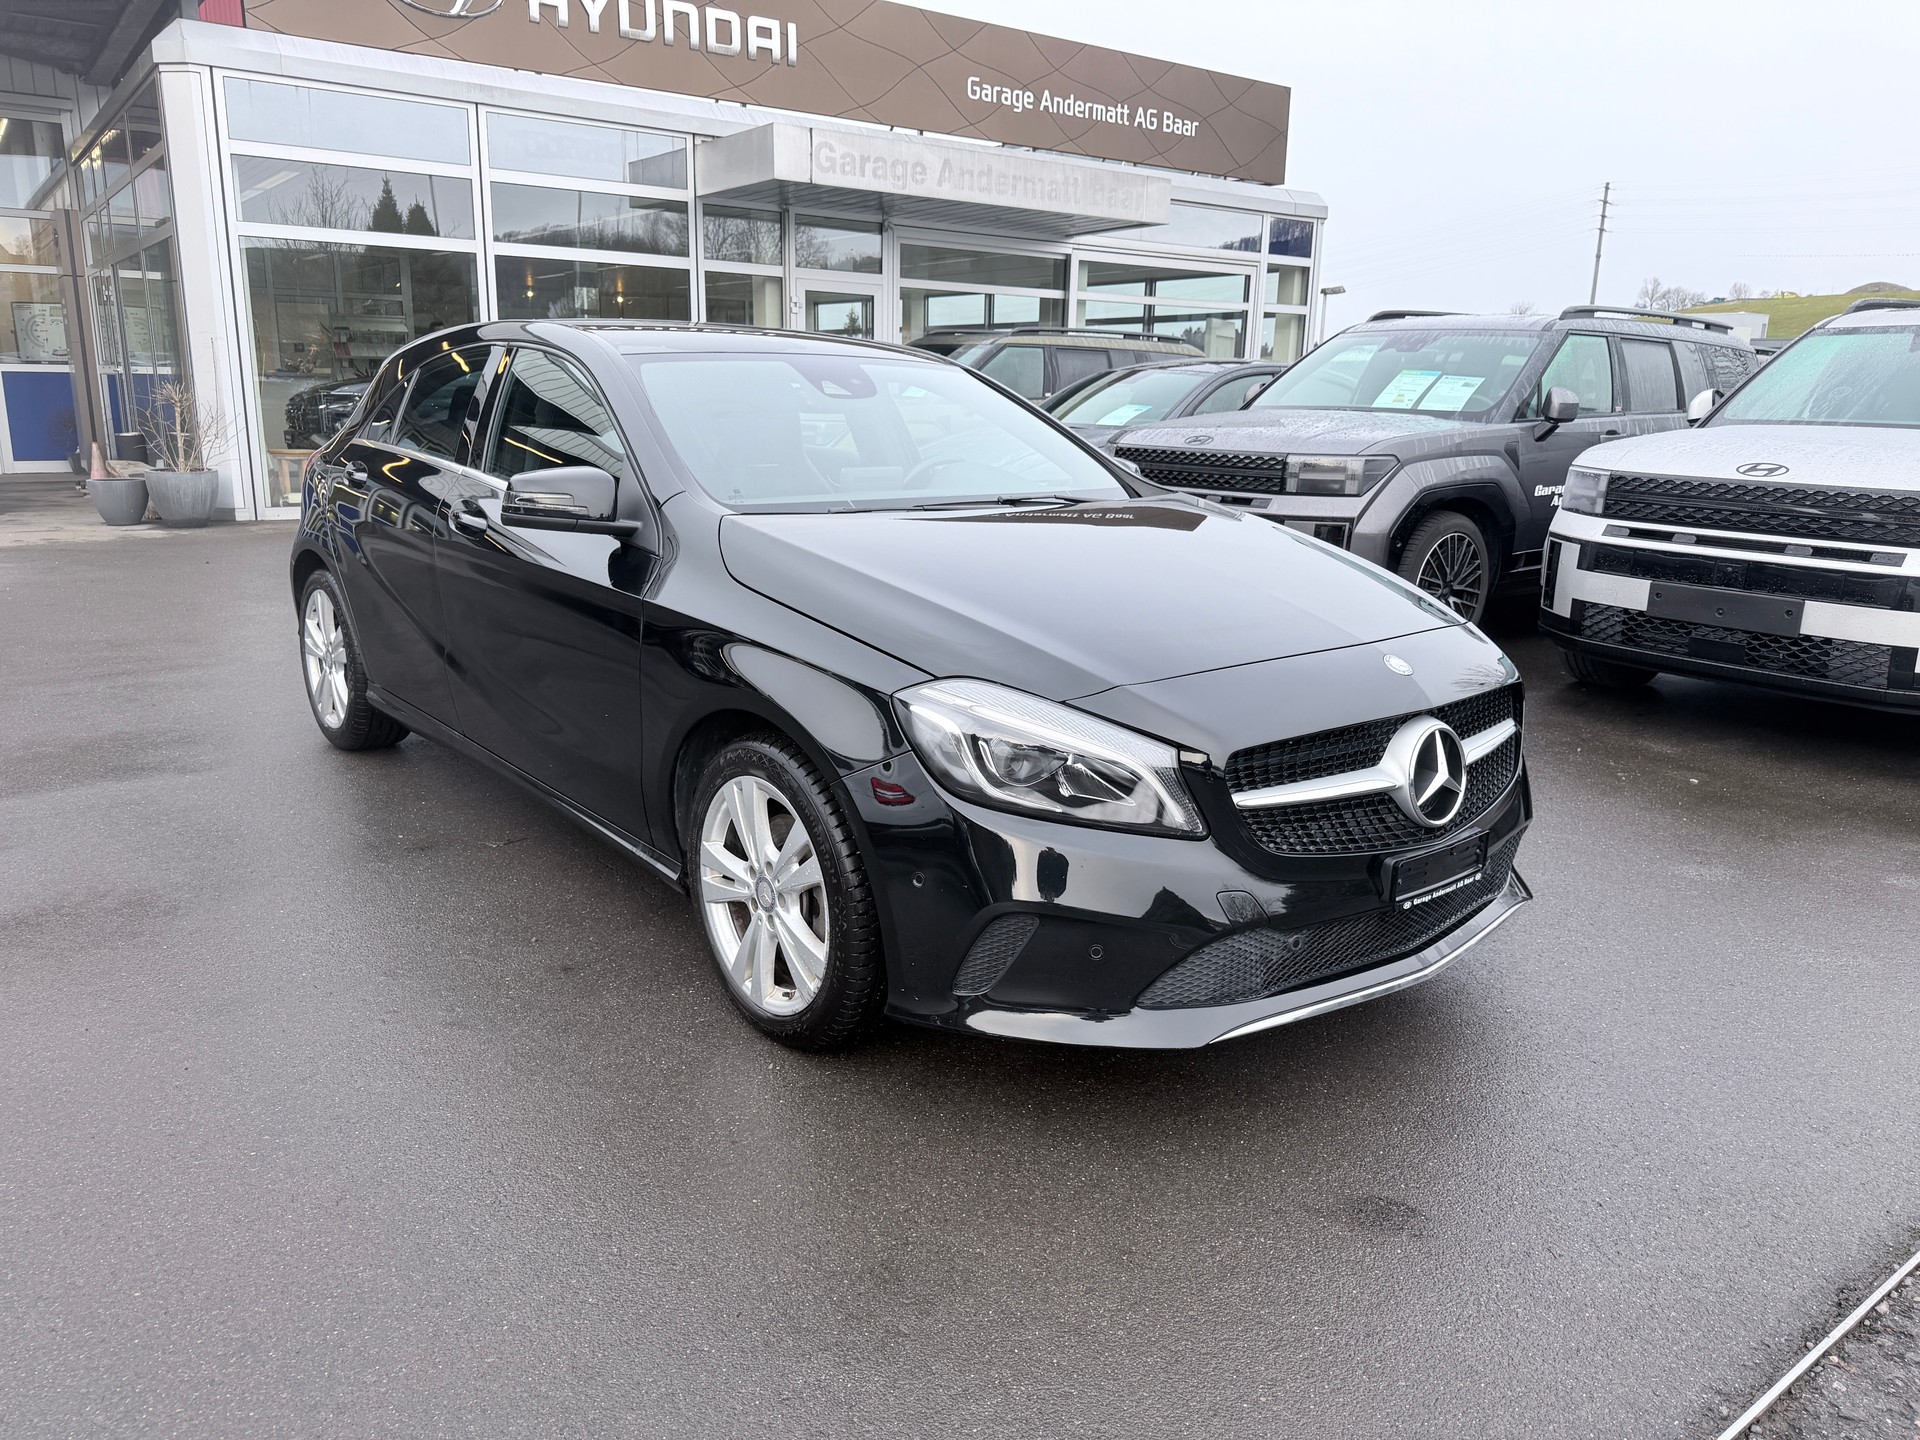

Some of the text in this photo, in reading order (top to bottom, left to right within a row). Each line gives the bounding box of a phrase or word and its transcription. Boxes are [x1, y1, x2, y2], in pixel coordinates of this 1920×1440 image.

[966, 76, 1200, 137] Garage Andermatt AG Baar
[814, 141, 927, 191] Garage
[936, 157, 1081, 206] Andermatt
[1413, 895, 1432, 905] Garage
[1432, 884, 1457, 898] Andermatt
